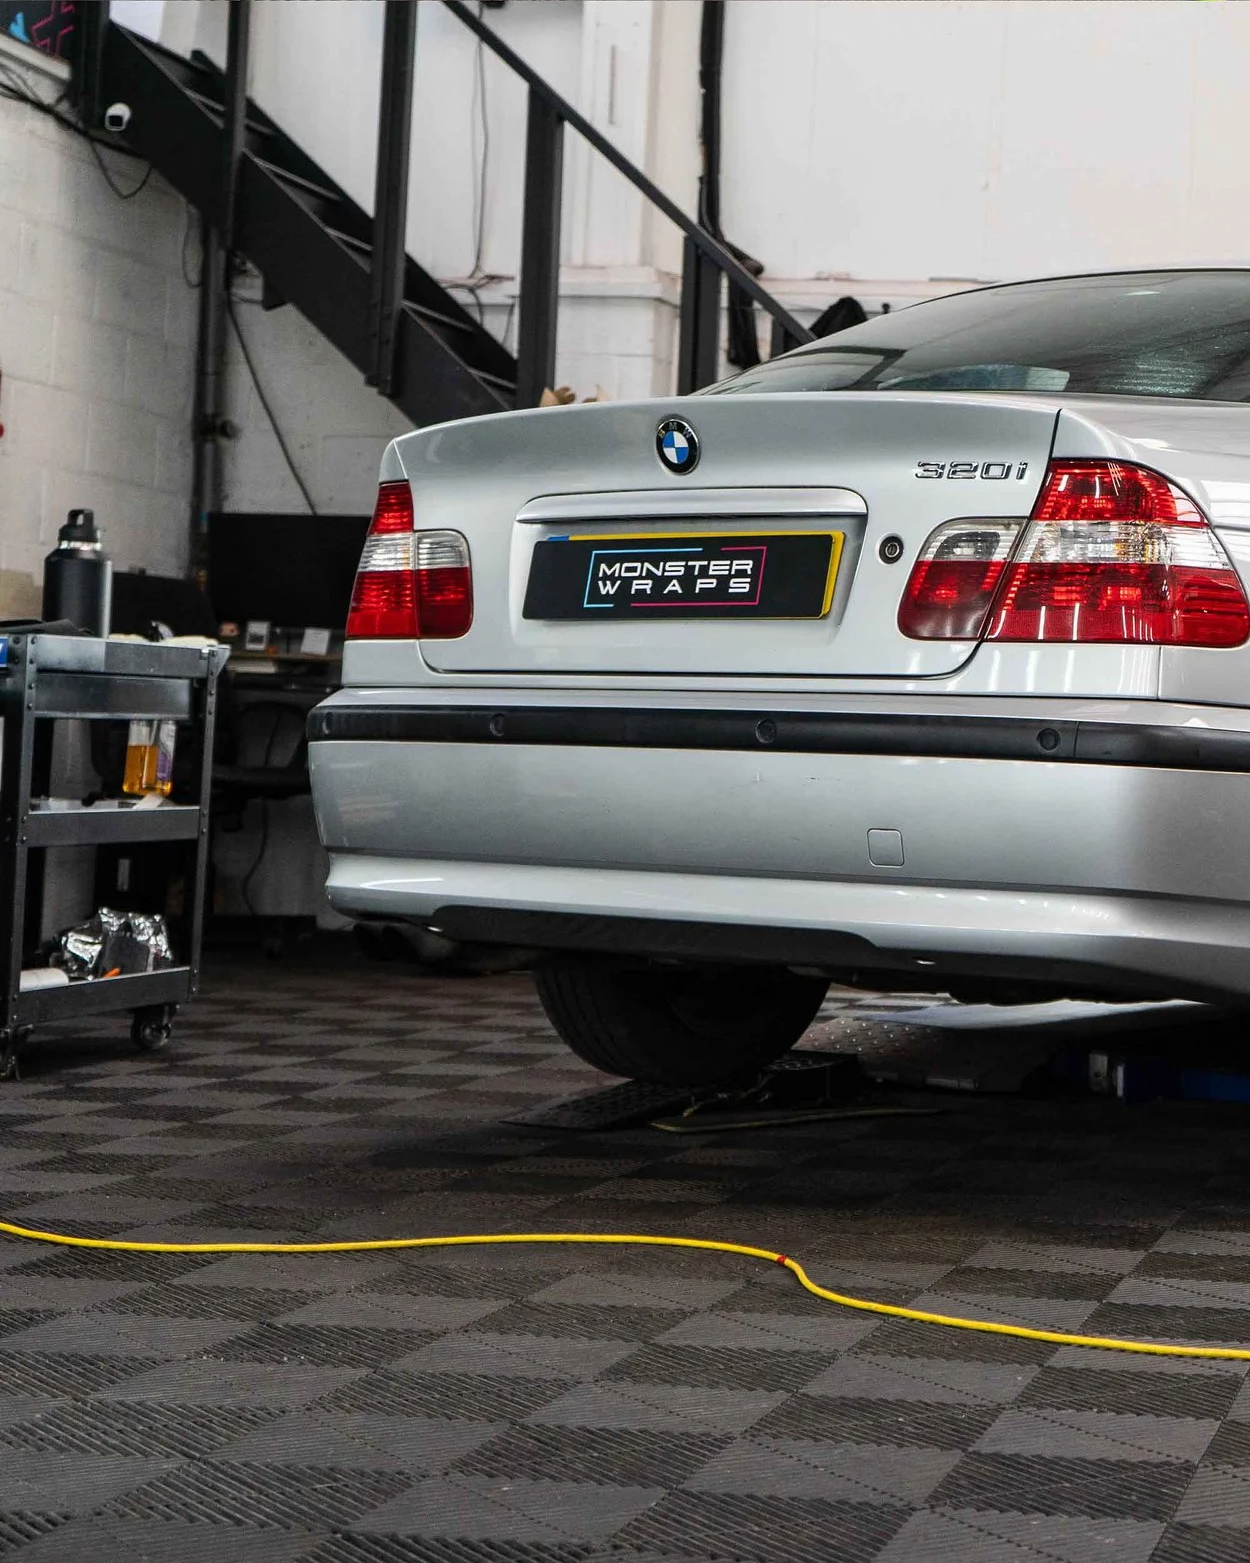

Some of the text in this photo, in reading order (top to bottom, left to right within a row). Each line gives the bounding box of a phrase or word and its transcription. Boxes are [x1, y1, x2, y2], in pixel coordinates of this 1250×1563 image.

[914, 460, 1029, 480] 320i
[597, 559, 754, 578] MONSTER
[597, 577, 752, 596] WRAPS
